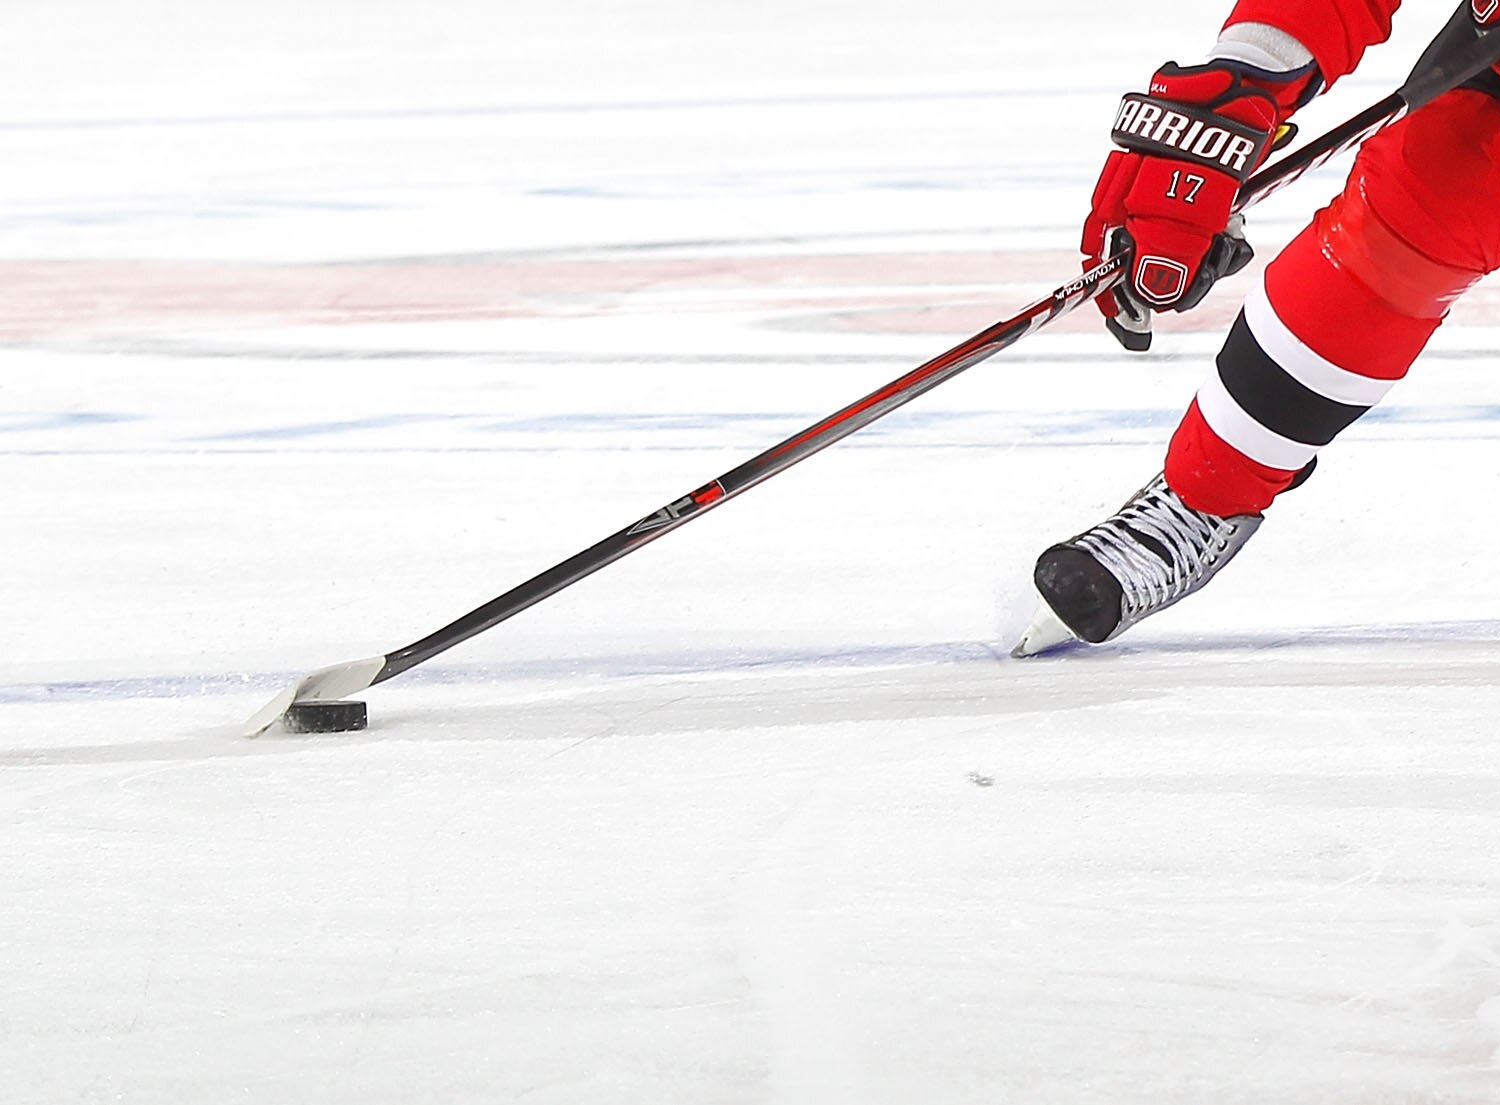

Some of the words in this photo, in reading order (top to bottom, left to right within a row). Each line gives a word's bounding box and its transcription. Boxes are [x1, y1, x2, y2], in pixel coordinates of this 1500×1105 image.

[1114, 98, 1255, 173] ARRIOR
[1166, 170, 1205, 204] 17
[1055, 262, 1115, 301] KOVALCHUK
